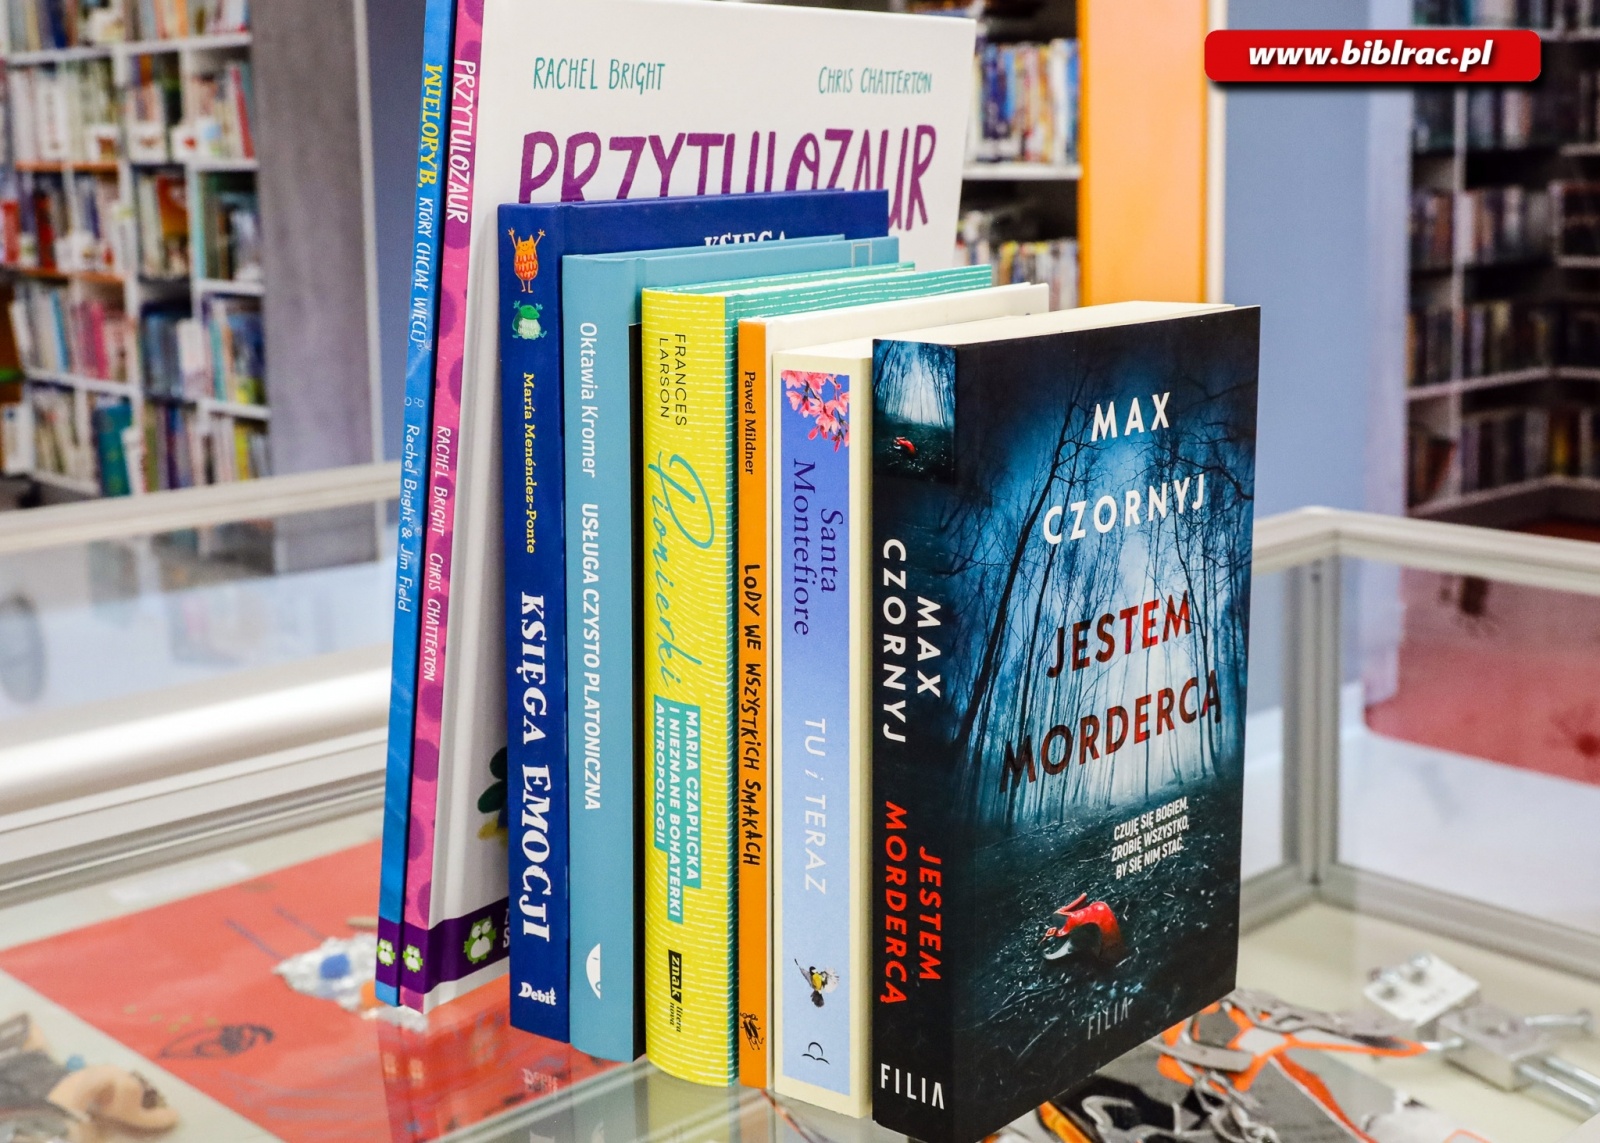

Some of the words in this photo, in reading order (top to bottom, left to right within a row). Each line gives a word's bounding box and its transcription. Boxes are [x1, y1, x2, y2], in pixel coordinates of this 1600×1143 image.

[533, 57, 598, 90] RACHEL
[608, 58, 665, 95] BRIGHT
[818, 66, 854, 94] CHRIS
[860, 67, 932, 95] CHATTERTON
[417, 63, 443, 188] WIELORYB,
[447, 59, 476, 224] PRZYTULOZAUR
[417, 197, 433, 238] KTÓRY
[414, 242, 431, 291] CHCIAŁ
[410, 297, 428, 346] WIĘCEJ
[524, 372, 536, 419] María
[580, 322, 598, 400] Oktawia
[659, 337, 670, 419] LARSON
[674, 333, 687, 427] FRANCES
[744, 371, 756, 414] Paweł
[404, 424, 420, 474] Rachel
[435, 425, 451, 477] RACHEL
[581, 405, 598, 478] Kromer
[744, 419, 757, 475] Mildner
[1090, 391, 1171, 442] MAX
[401, 478, 417, 523] Bright
[431, 486, 448, 537] BRIGHT
[524, 424, 537, 554] Menéndez-Ponte
[1042, 473, 1205, 545] CZORNYJ
[400, 544, 414, 570] Jim
[401, 528, 413, 539] &
[581, 503, 599, 584] USŁUGA
[648, 451, 714, 688] Pionierki
[793, 458, 818, 636] Montefiore
[820, 508, 844, 593] Santa
[398, 576, 412, 612] Field
[428, 552, 444, 592] CHRIS
[423, 598, 441, 682] CHATTERTON
[582, 588, 600, 669] CZYSTO
[743, 624, 762, 650] WE
[882, 537, 907, 743] CZORNYJ
[917, 595, 942, 698] MAX
[1046, 589, 1192, 679] JESTEM
[516, 591, 547, 745] KSIĘGA
[583, 672, 601, 810] PLATONICZNA
[669, 718, 681, 809] NIEZNANE
[685, 710, 698, 770] MARIA
[804, 718, 826, 757] TU
[1000, 669, 1222, 793] MORDERCA
[655, 701, 666, 844] ANTROPOLOGII
[804, 768, 824, 781] i
[518, 764, 551, 943] EMOCJI
[686, 776, 699, 880] CZAPLICKA
[740, 778, 763, 866] SMAKACH
[804, 794, 827, 895] TERAZ
[1111, 836, 1142, 862] ZROBIĘ
[1143, 815, 1190, 847] WSZYSTKO,
[1114, 817, 1140, 841] CZUJĘ
[1140, 811, 1154, 829] SIĘ
[1155, 796, 1189, 823] BOGIEM.
[669, 813, 681, 917] BOHATERKI
[1116, 861, 1128, 880] BY
[1128, 854, 1143, 873] SIĘ
[1144, 846, 1161, 866] NIM
[880, 800, 907, 1005] MORDERCA
[918, 846, 942, 980] JESTEM
[518, 982, 557, 1006] Debit
[670, 952, 682, 1000] znak
[880, 1063, 945, 1110] FILIA
